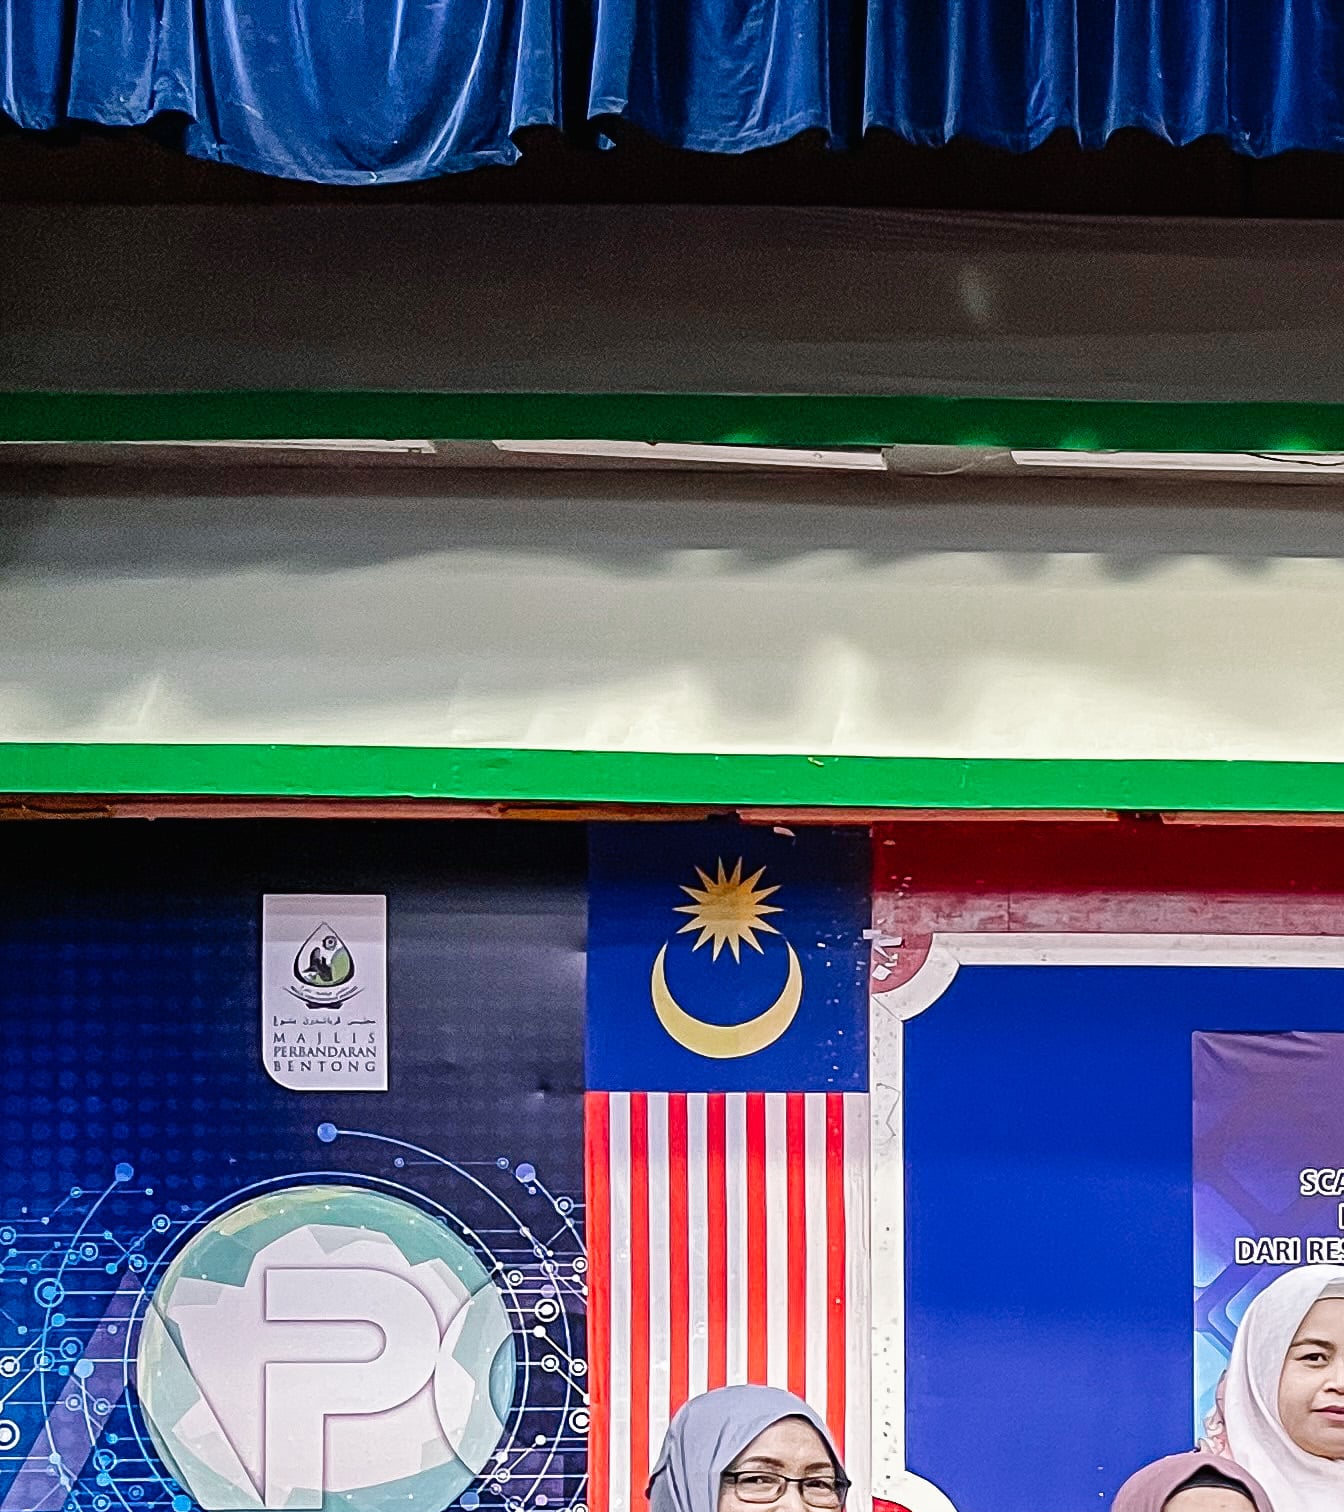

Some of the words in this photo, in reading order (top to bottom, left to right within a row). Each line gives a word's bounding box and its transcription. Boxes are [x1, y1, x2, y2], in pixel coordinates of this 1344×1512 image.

[273, 1031, 375, 1045] MAJLIS
[273, 1046, 377, 1058] PERBANDARAN
[273, 1060, 376, 1073] BENTONG
[1236, 1238, 1300, 1263] DARI
